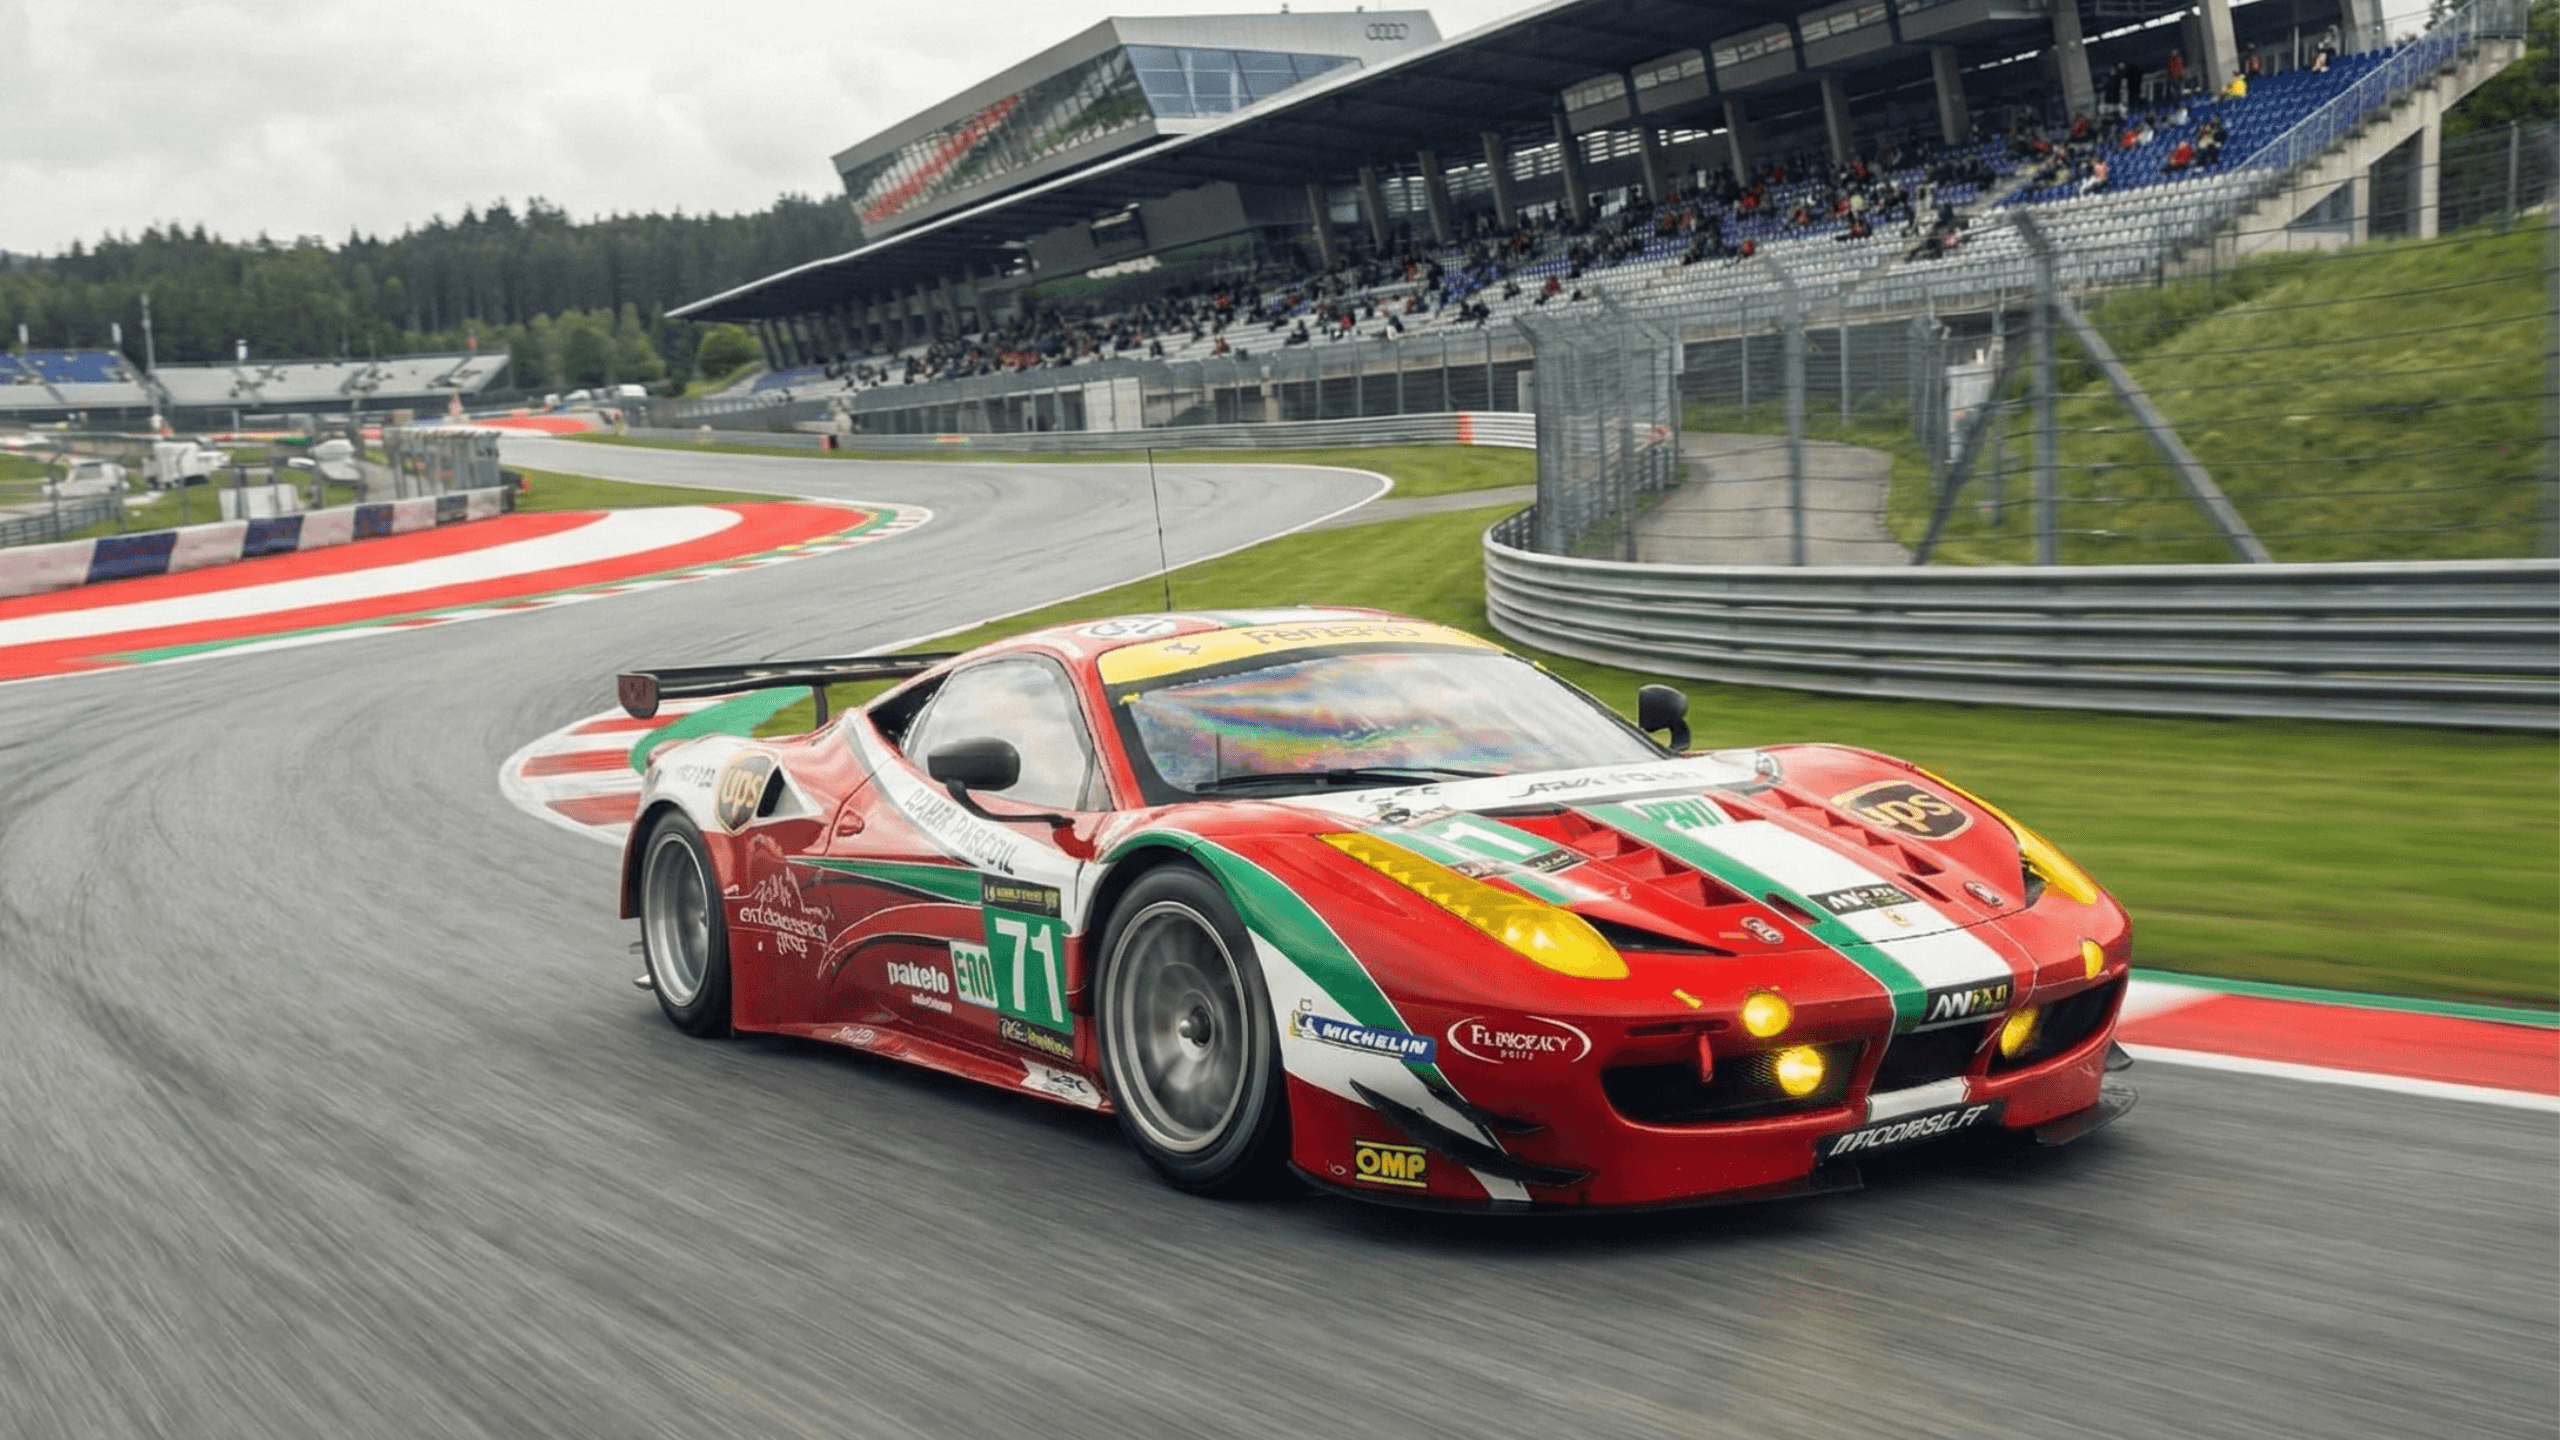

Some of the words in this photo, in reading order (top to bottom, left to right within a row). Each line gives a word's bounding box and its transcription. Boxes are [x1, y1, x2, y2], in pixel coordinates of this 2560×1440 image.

[1858, 793, 1953, 833] ups
[887, 960, 950, 995] pakelo
[994, 916, 1064, 1024] 71
[1321, 1022, 1429, 1055] MICHELIN
[1355, 1147, 1426, 1179] OMP
